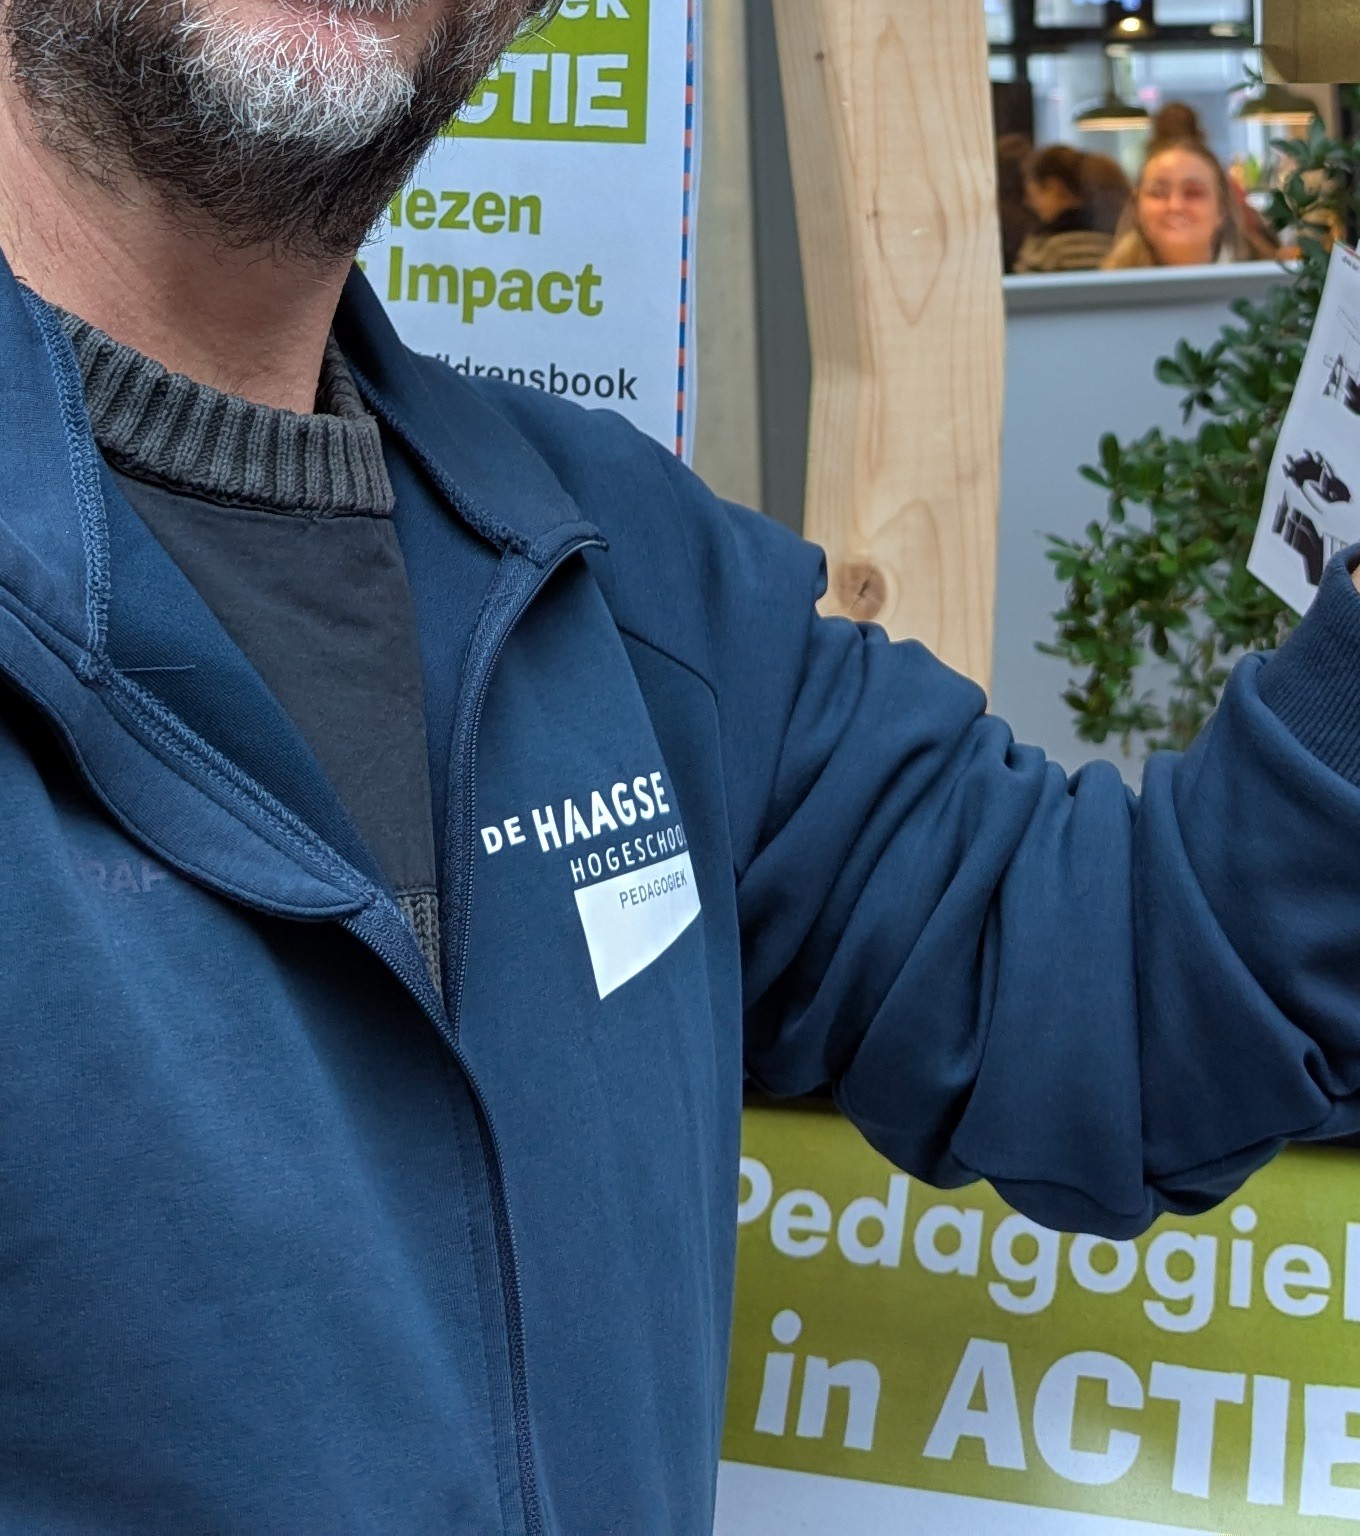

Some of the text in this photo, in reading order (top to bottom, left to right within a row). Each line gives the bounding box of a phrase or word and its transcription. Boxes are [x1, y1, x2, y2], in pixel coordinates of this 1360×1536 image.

[458, 52, 629, 129] CTIE
[387, 246, 604, 324] Impact
[480, 771, 671, 855] DE HAAGSE
[618, 869, 689, 910] PEDAGOGIEK
[753, 1310, 881, 1451] in
